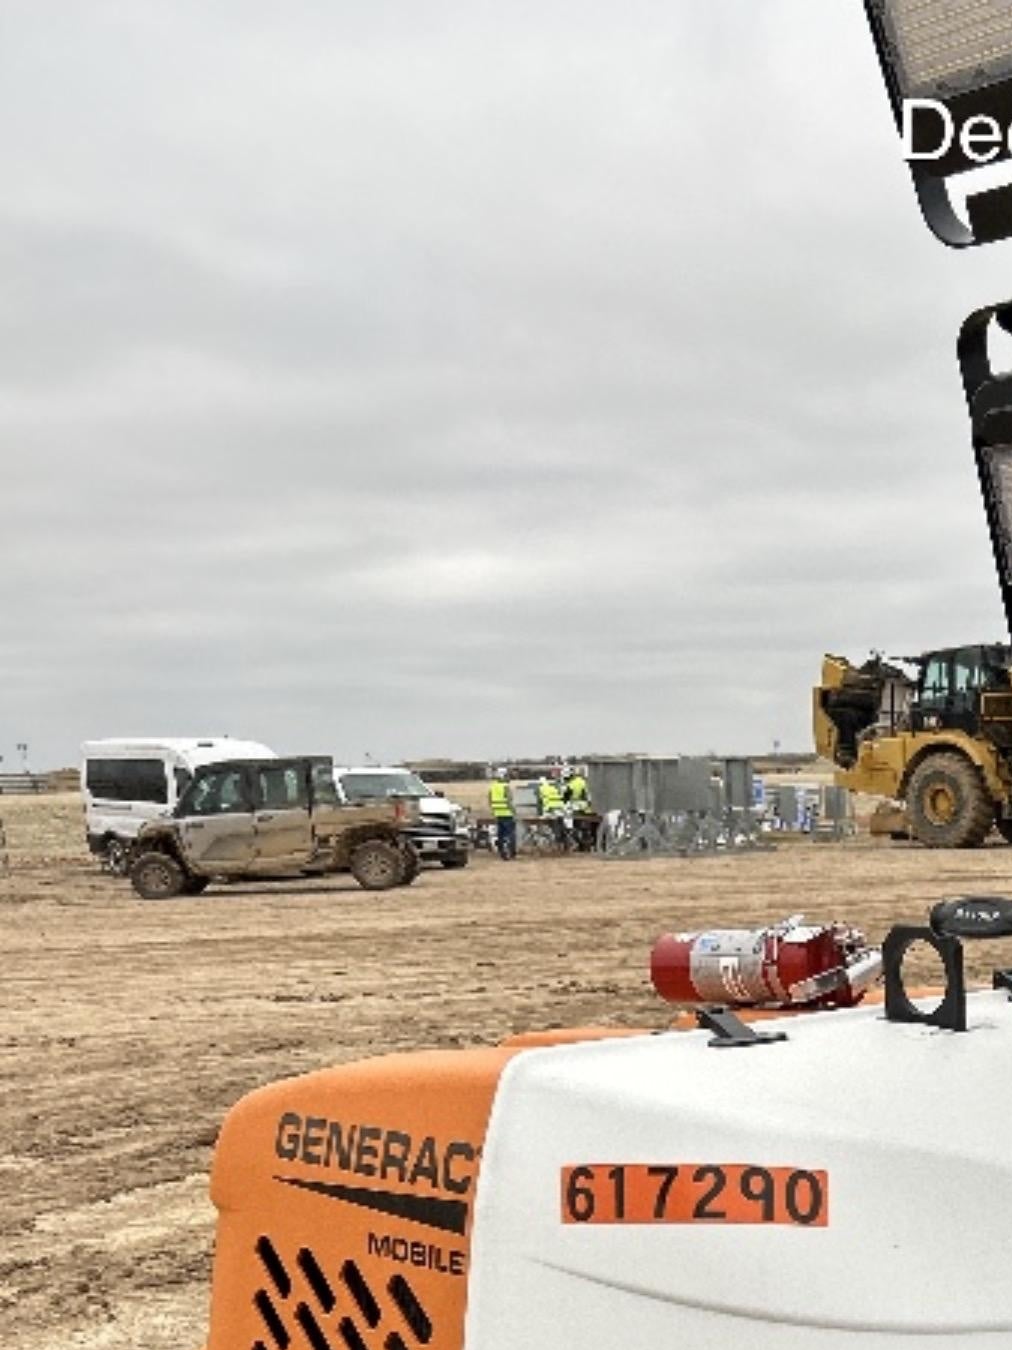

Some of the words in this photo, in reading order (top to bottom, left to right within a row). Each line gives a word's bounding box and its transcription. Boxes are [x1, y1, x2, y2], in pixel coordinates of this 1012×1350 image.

[275, 1112, 474, 1193] GENERAC
[566, 1166, 823, 1224] 617290
[367, 1232, 466, 1275] MOBILE
